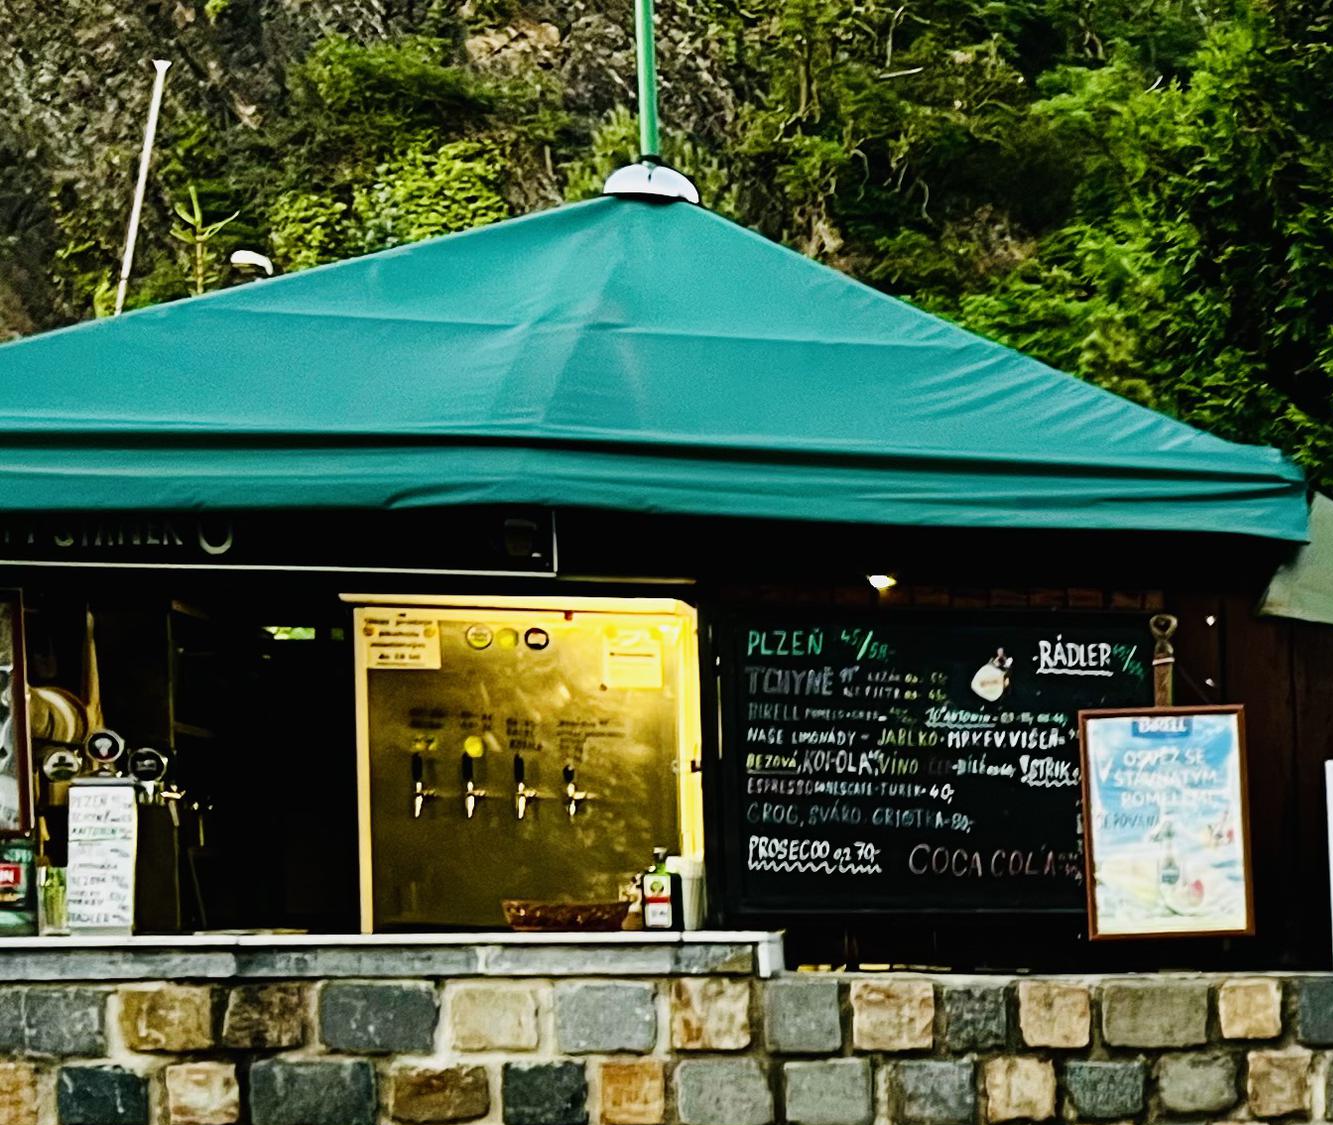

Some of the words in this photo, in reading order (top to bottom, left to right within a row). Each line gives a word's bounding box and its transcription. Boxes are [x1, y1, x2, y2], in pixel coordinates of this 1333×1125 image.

[747, 628, 824, 656] PLZEŇ
[1039, 634, 1112, 667] RÁDLER
[745, 666, 834, 695] TCHYNĚ
[877, 727, 938, 747] JABLKO
[908, 843, 983, 877] COCA
